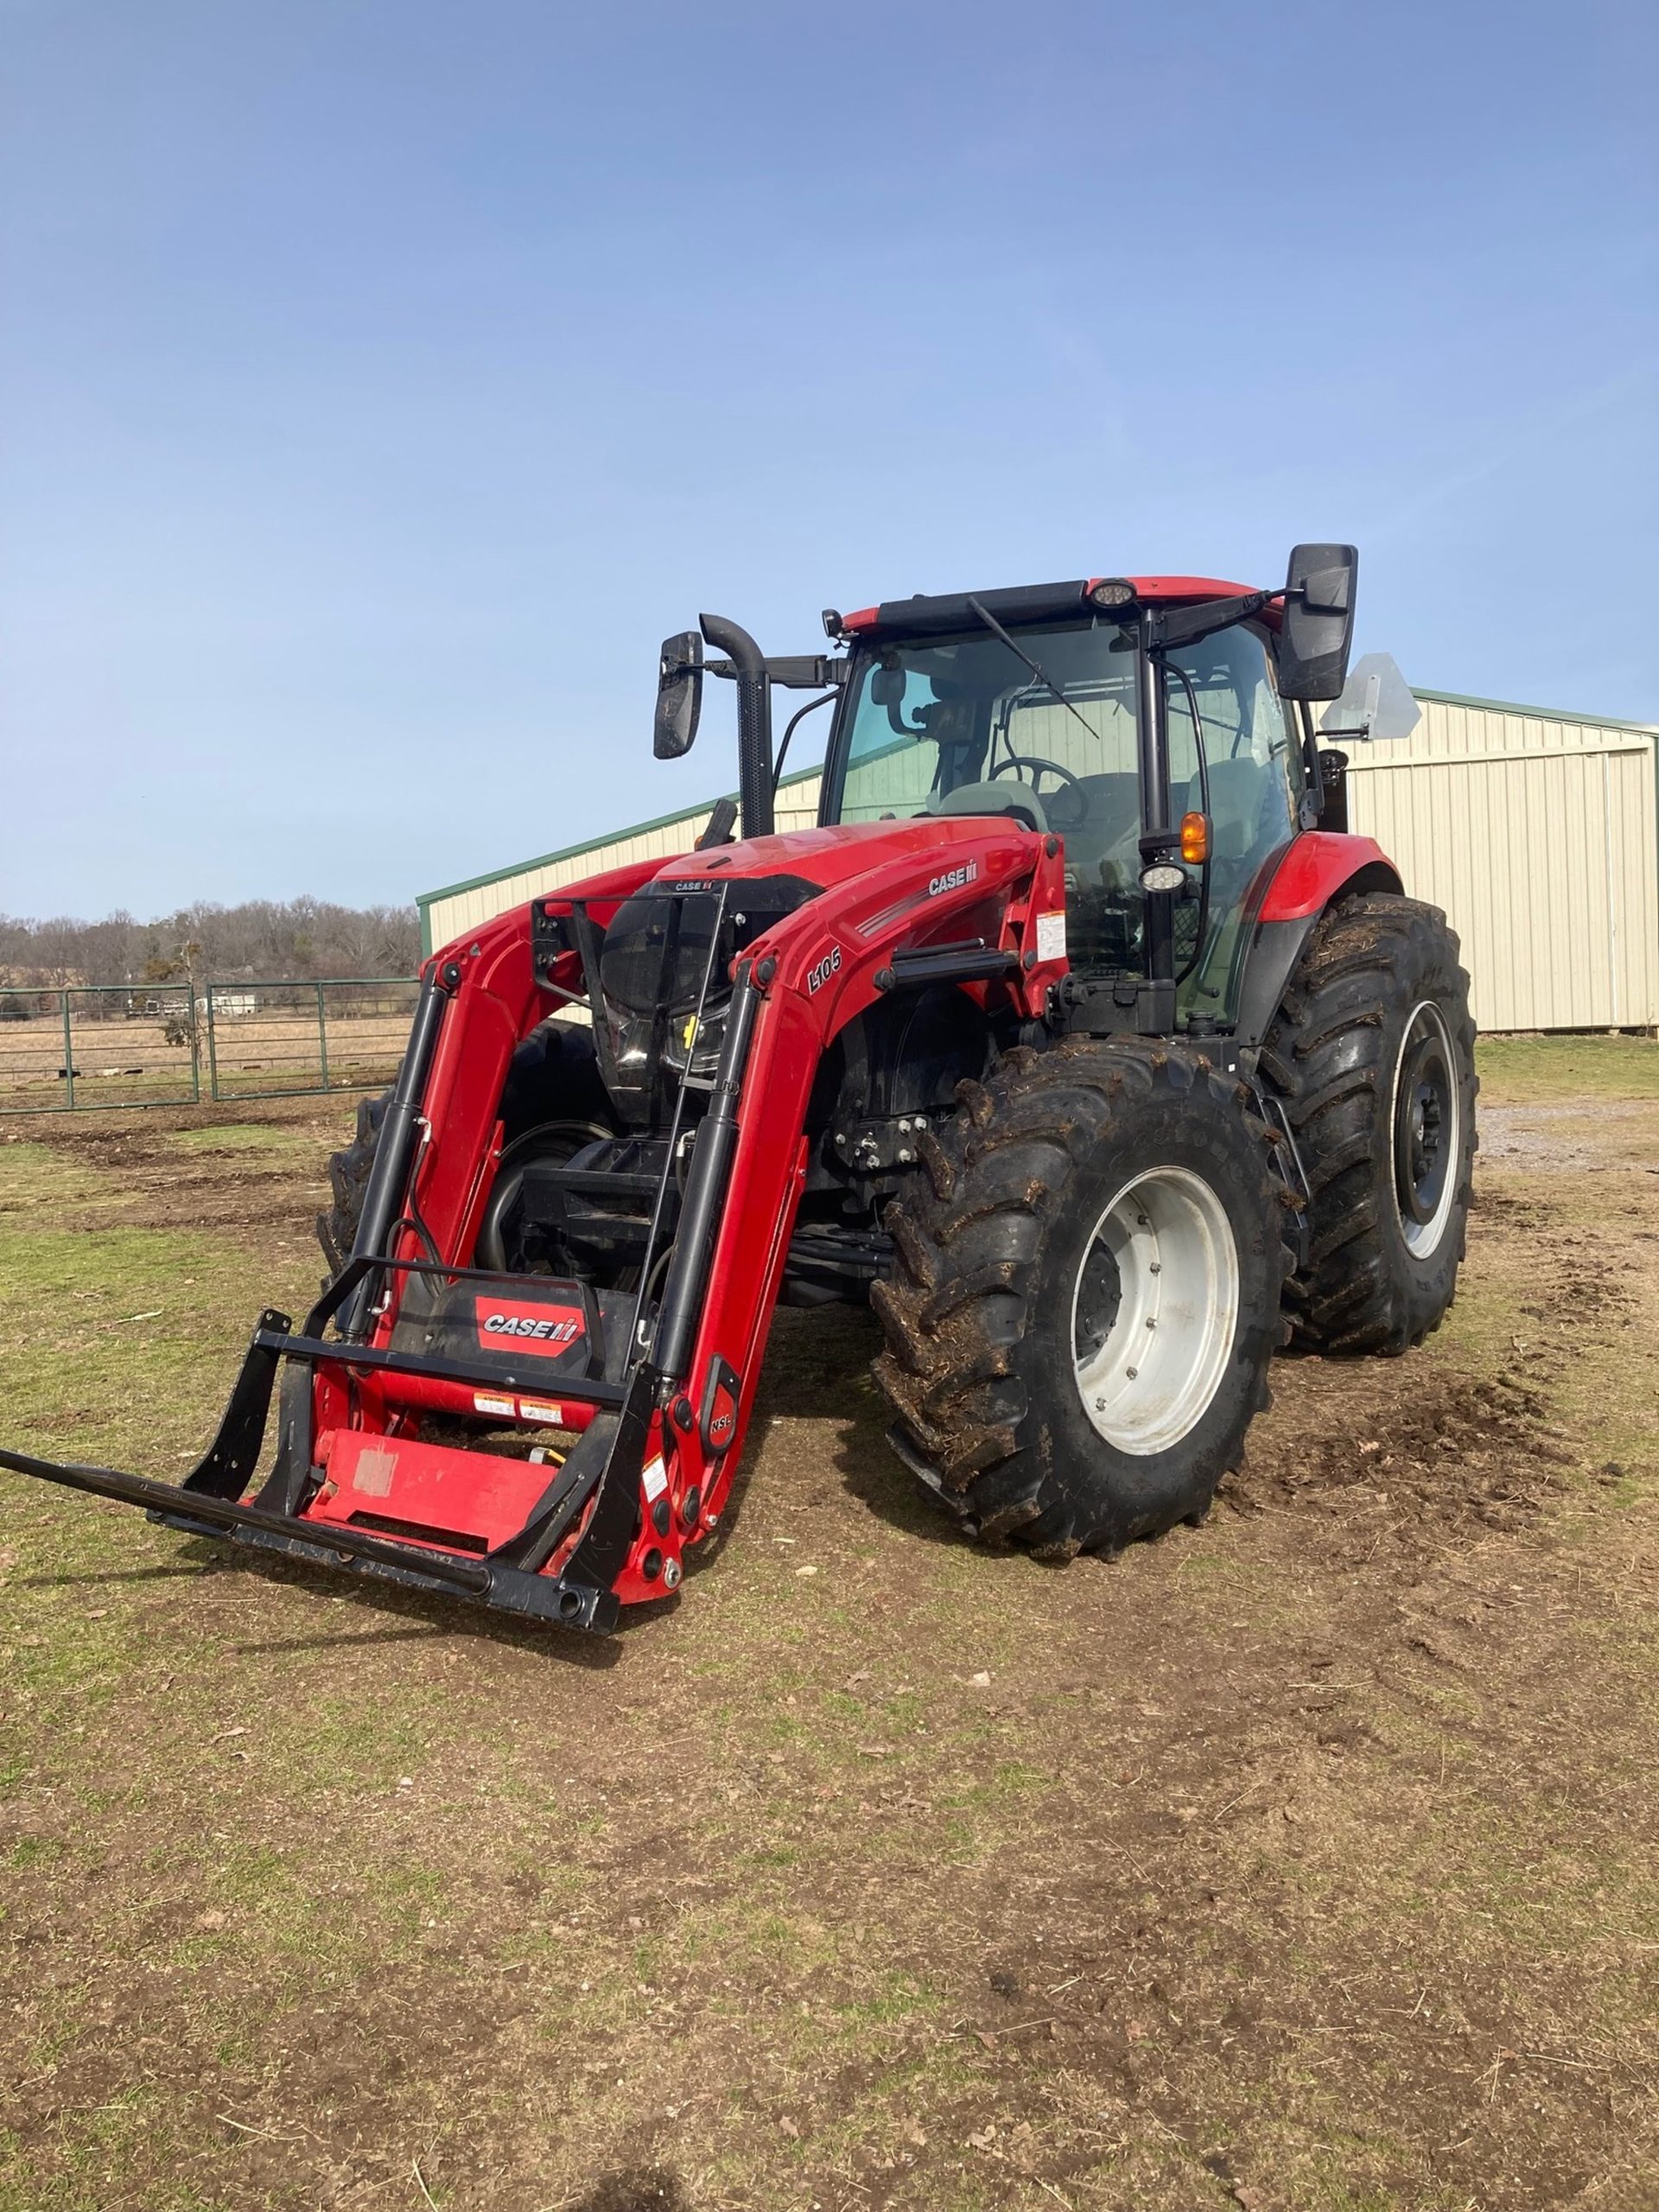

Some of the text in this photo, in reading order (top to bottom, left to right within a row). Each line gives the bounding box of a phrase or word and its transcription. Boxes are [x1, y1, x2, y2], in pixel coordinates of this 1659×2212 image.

[676, 882, 701, 892] CASE
[929, 868, 965, 896] CASE
[807, 945, 842, 996] L105
[483, 1313, 554, 1338] CASE
[710, 1414, 732, 1434] NSL
